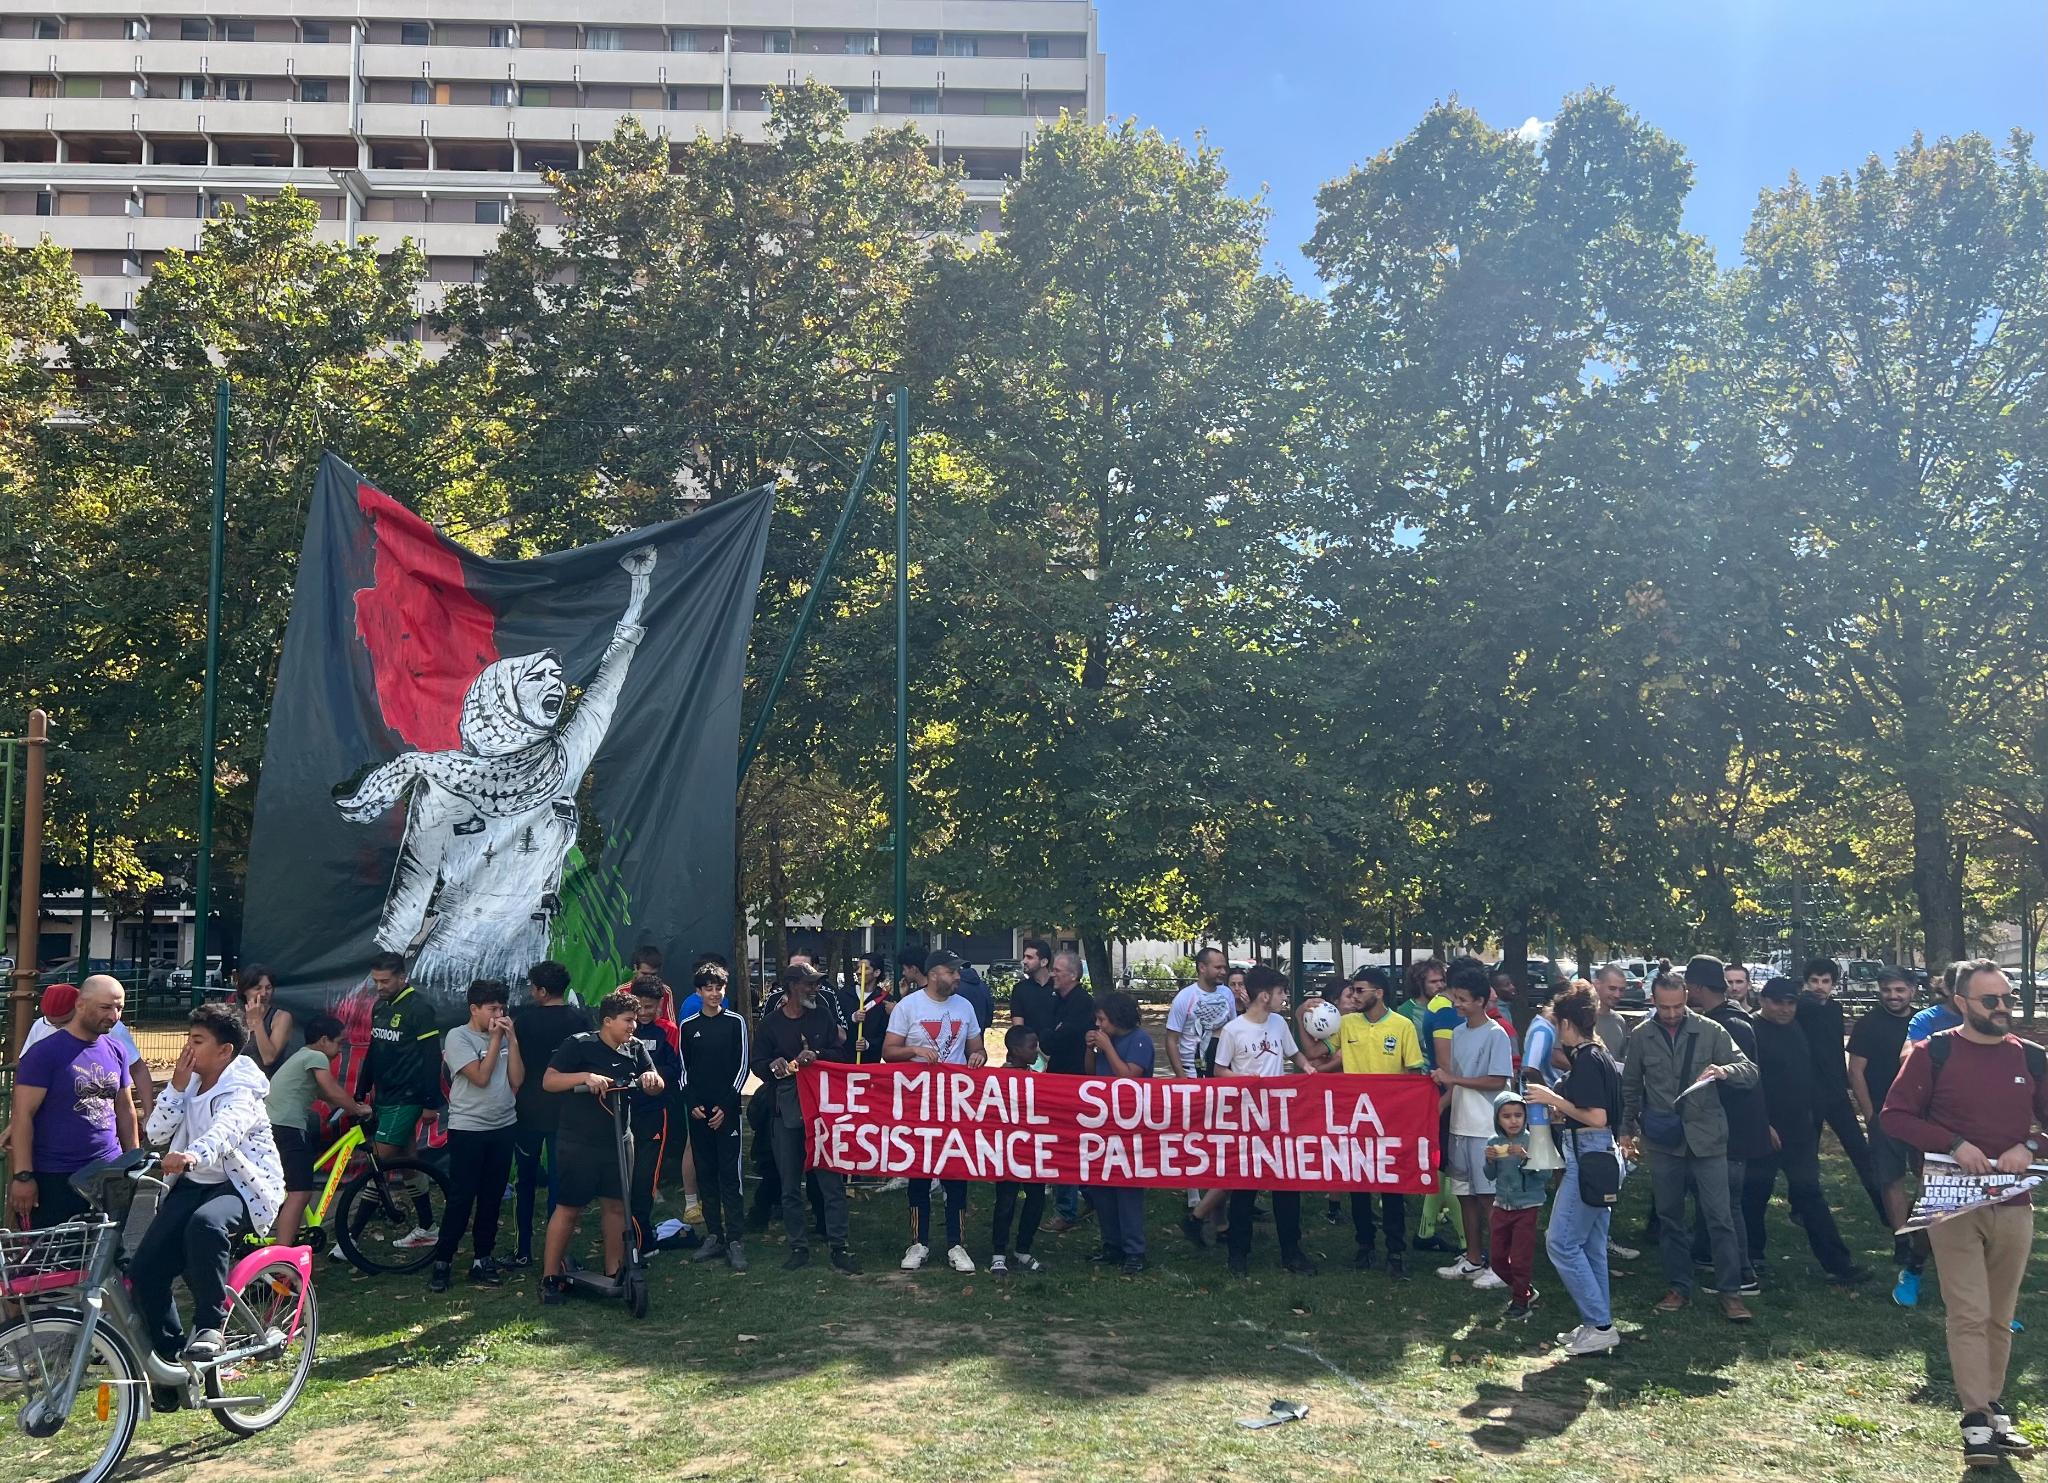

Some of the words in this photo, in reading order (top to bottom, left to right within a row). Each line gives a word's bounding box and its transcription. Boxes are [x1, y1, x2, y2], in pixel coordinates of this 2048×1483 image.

[818, 1071, 870, 1114] LE
[893, 1070, 1049, 1126] MIRAIL
[1075, 1077, 1297, 1138] SOUTIENT
[1325, 1089, 1385, 1137] LA
[813, 1113, 1060, 1181] RÉSISTANCE
[1079, 1131, 1402, 1184] PALESTINIENNE
[1418, 1136, 1432, 1185] !
[1925, 1187, 1983, 1198] GEORGES
